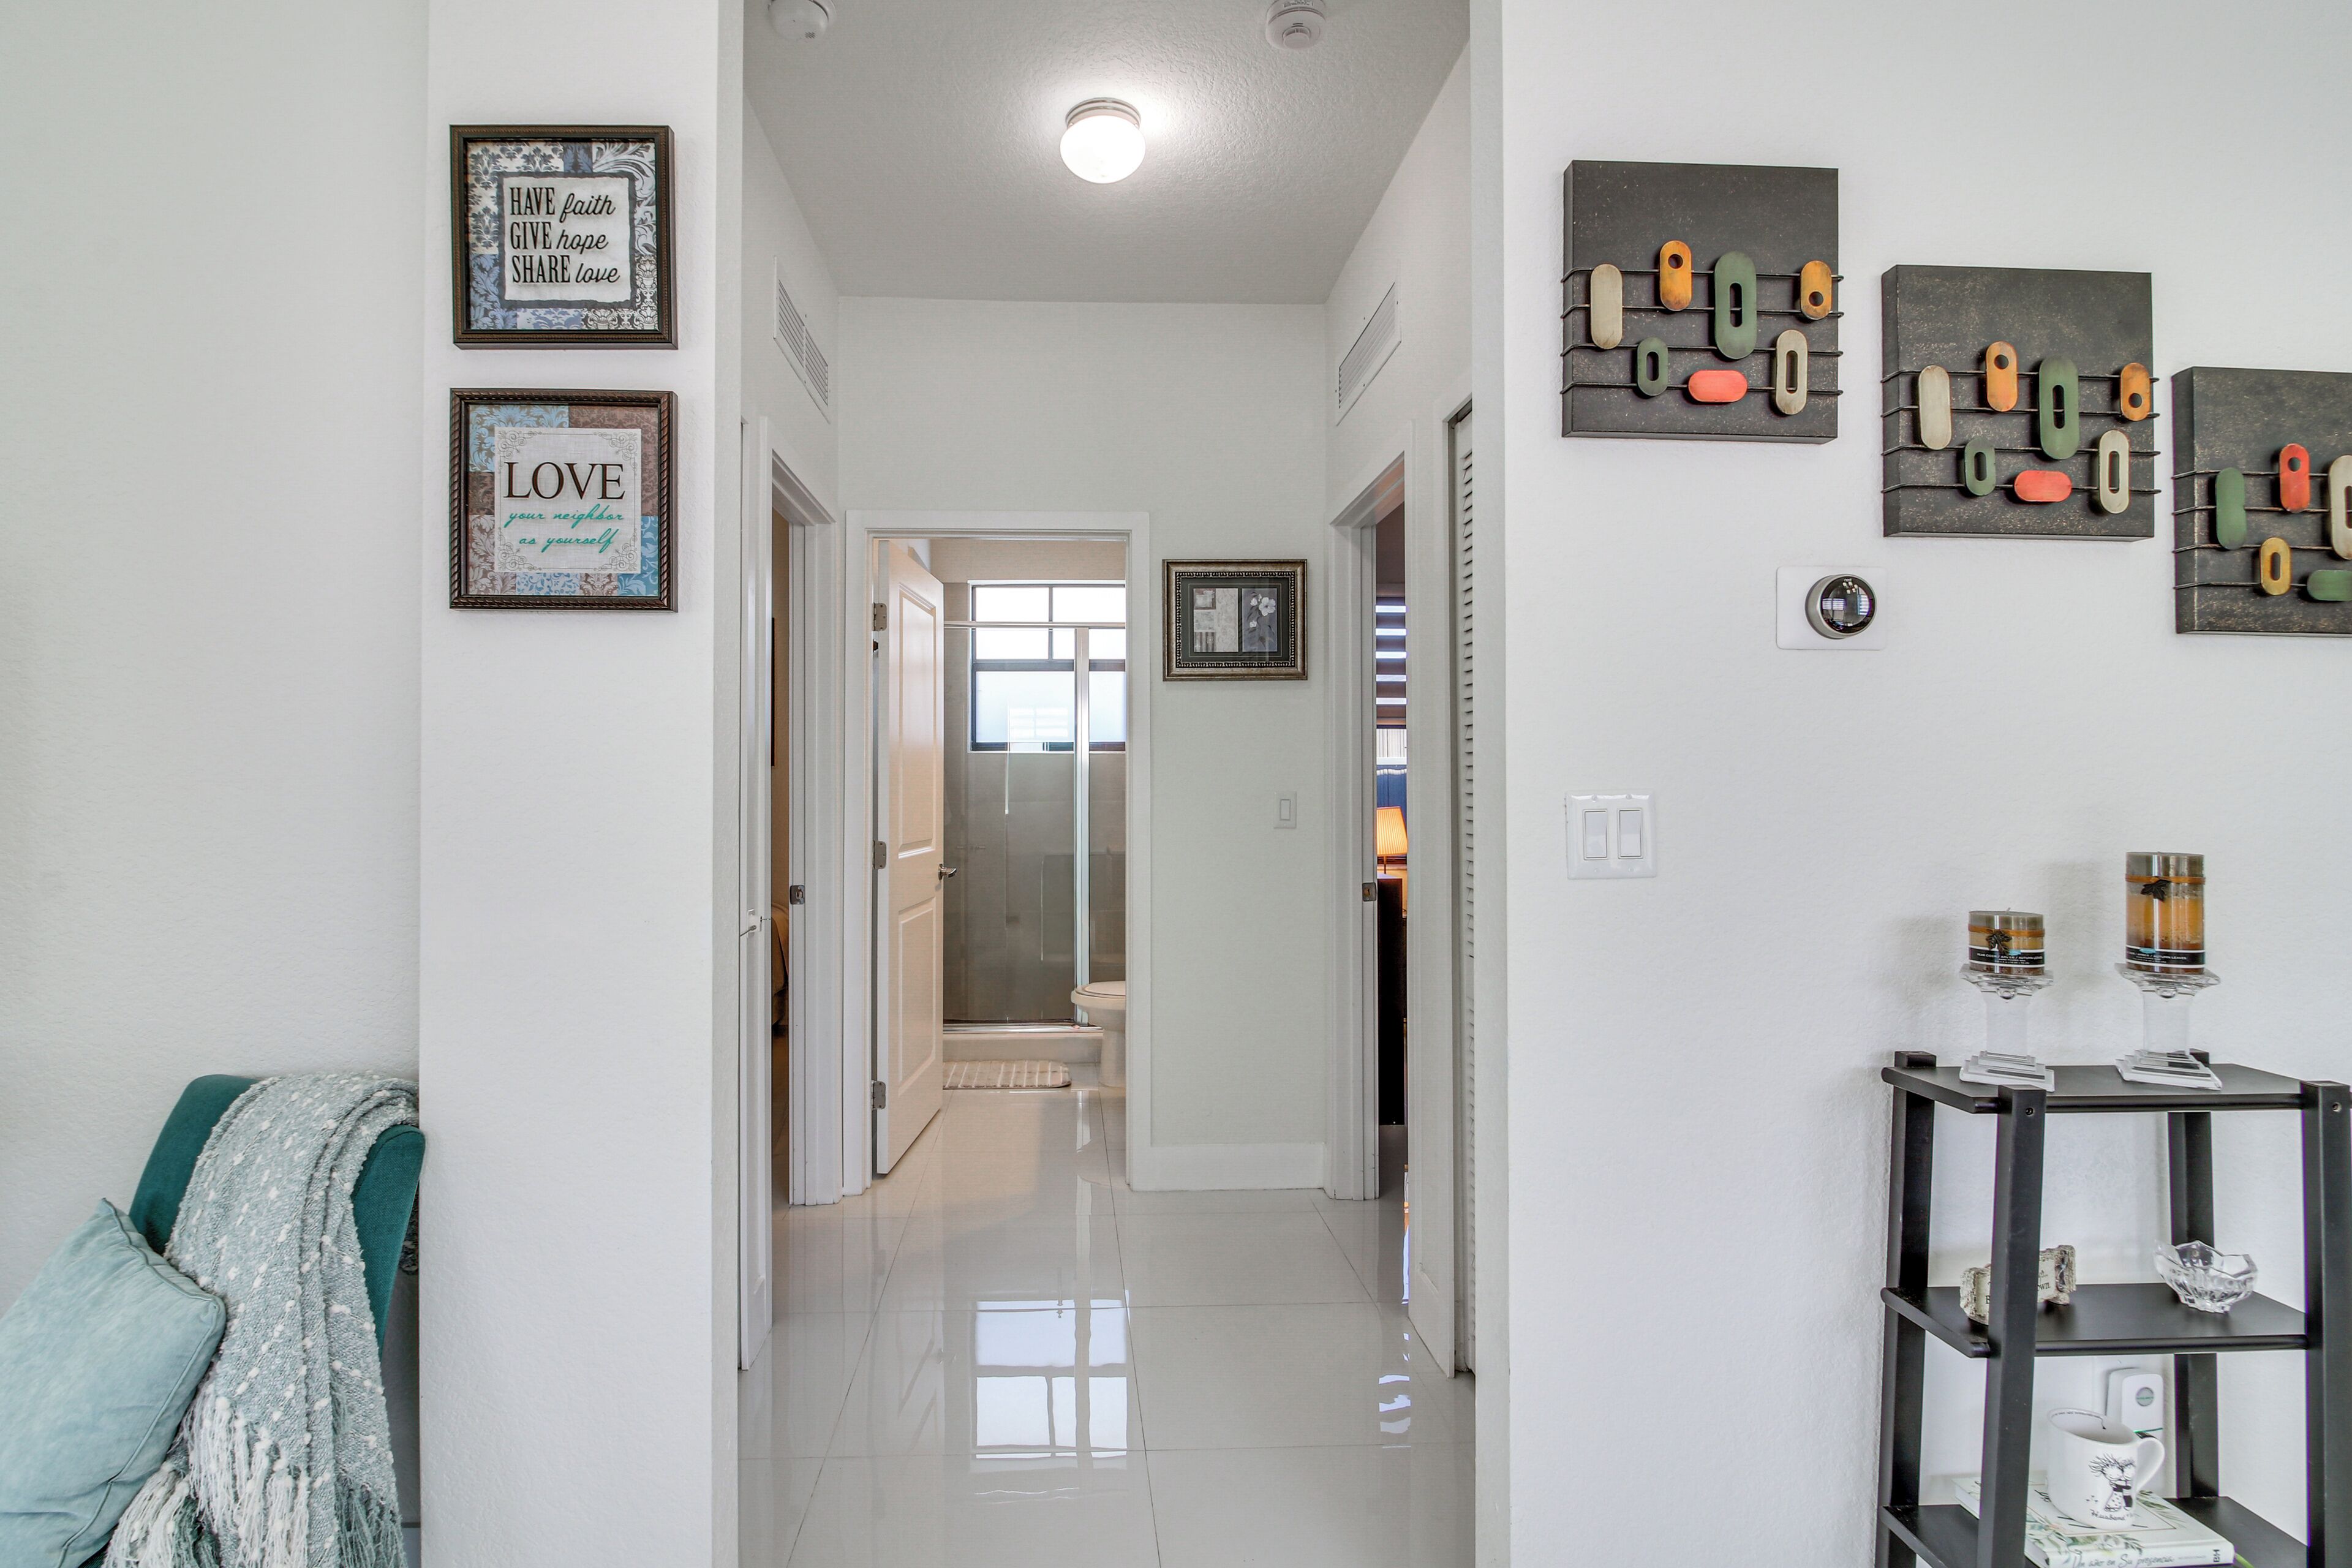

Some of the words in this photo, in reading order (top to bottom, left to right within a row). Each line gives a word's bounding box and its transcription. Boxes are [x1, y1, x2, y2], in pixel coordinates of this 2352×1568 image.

[509, 187, 556, 216] HAVE
[559, 192, 616, 224] faith
[510, 221, 552, 250] GIVE
[556, 229, 609, 255] hope
[511, 254, 571, 284] SHARE
[575, 263, 620, 284] love
[503, 462, 625, 500] LOVE
[503, 513, 546, 529] your
[553, 503, 624, 529] neighbor
[541, 528, 619, 553] yourself
[2117, 1553, 2132, 1568] Su
